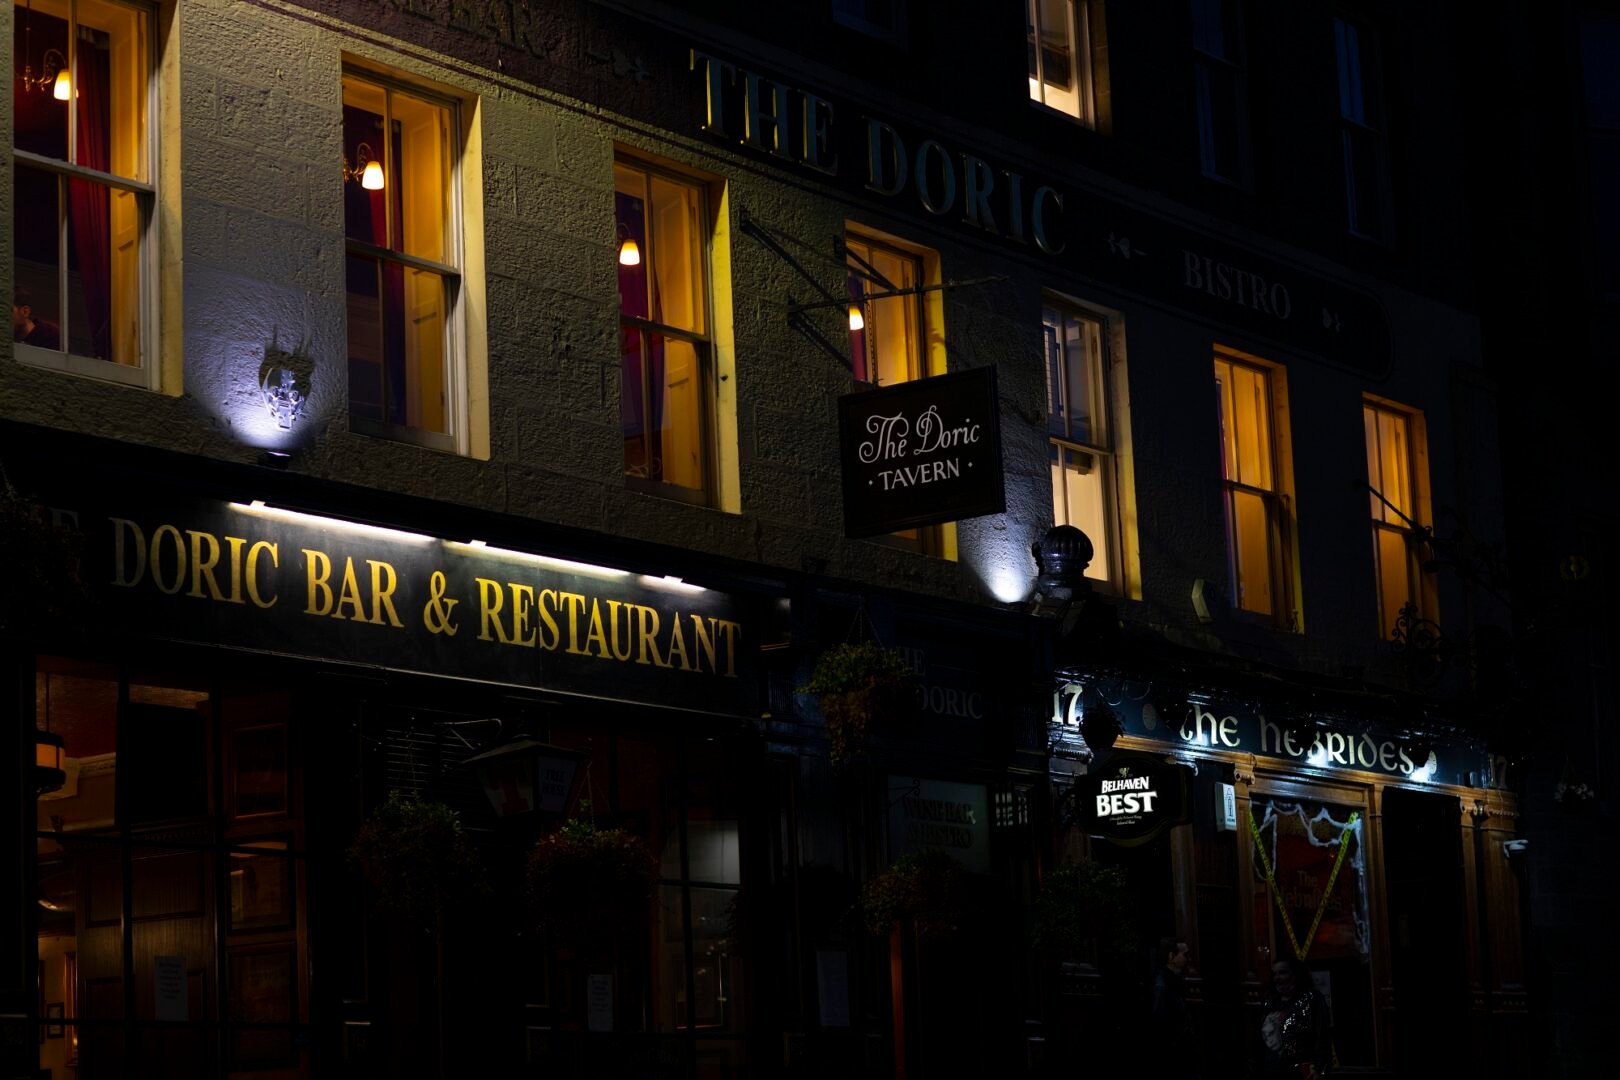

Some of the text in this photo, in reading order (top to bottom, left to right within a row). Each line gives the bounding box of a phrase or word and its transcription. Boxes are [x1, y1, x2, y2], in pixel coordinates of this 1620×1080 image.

[688, 47, 1067, 257] THE DORIC
[1177, 247, 1292, 320] BISTRO
[858, 404, 981, 464] The Doric
[877, 457, 960, 491] TAVERN
[107, 516, 743, 679] DORIC BAR & RESTAURANT
[1096, 790, 1158, 817] BEST
[1101, 776, 1150, 794] BELHAVEN
